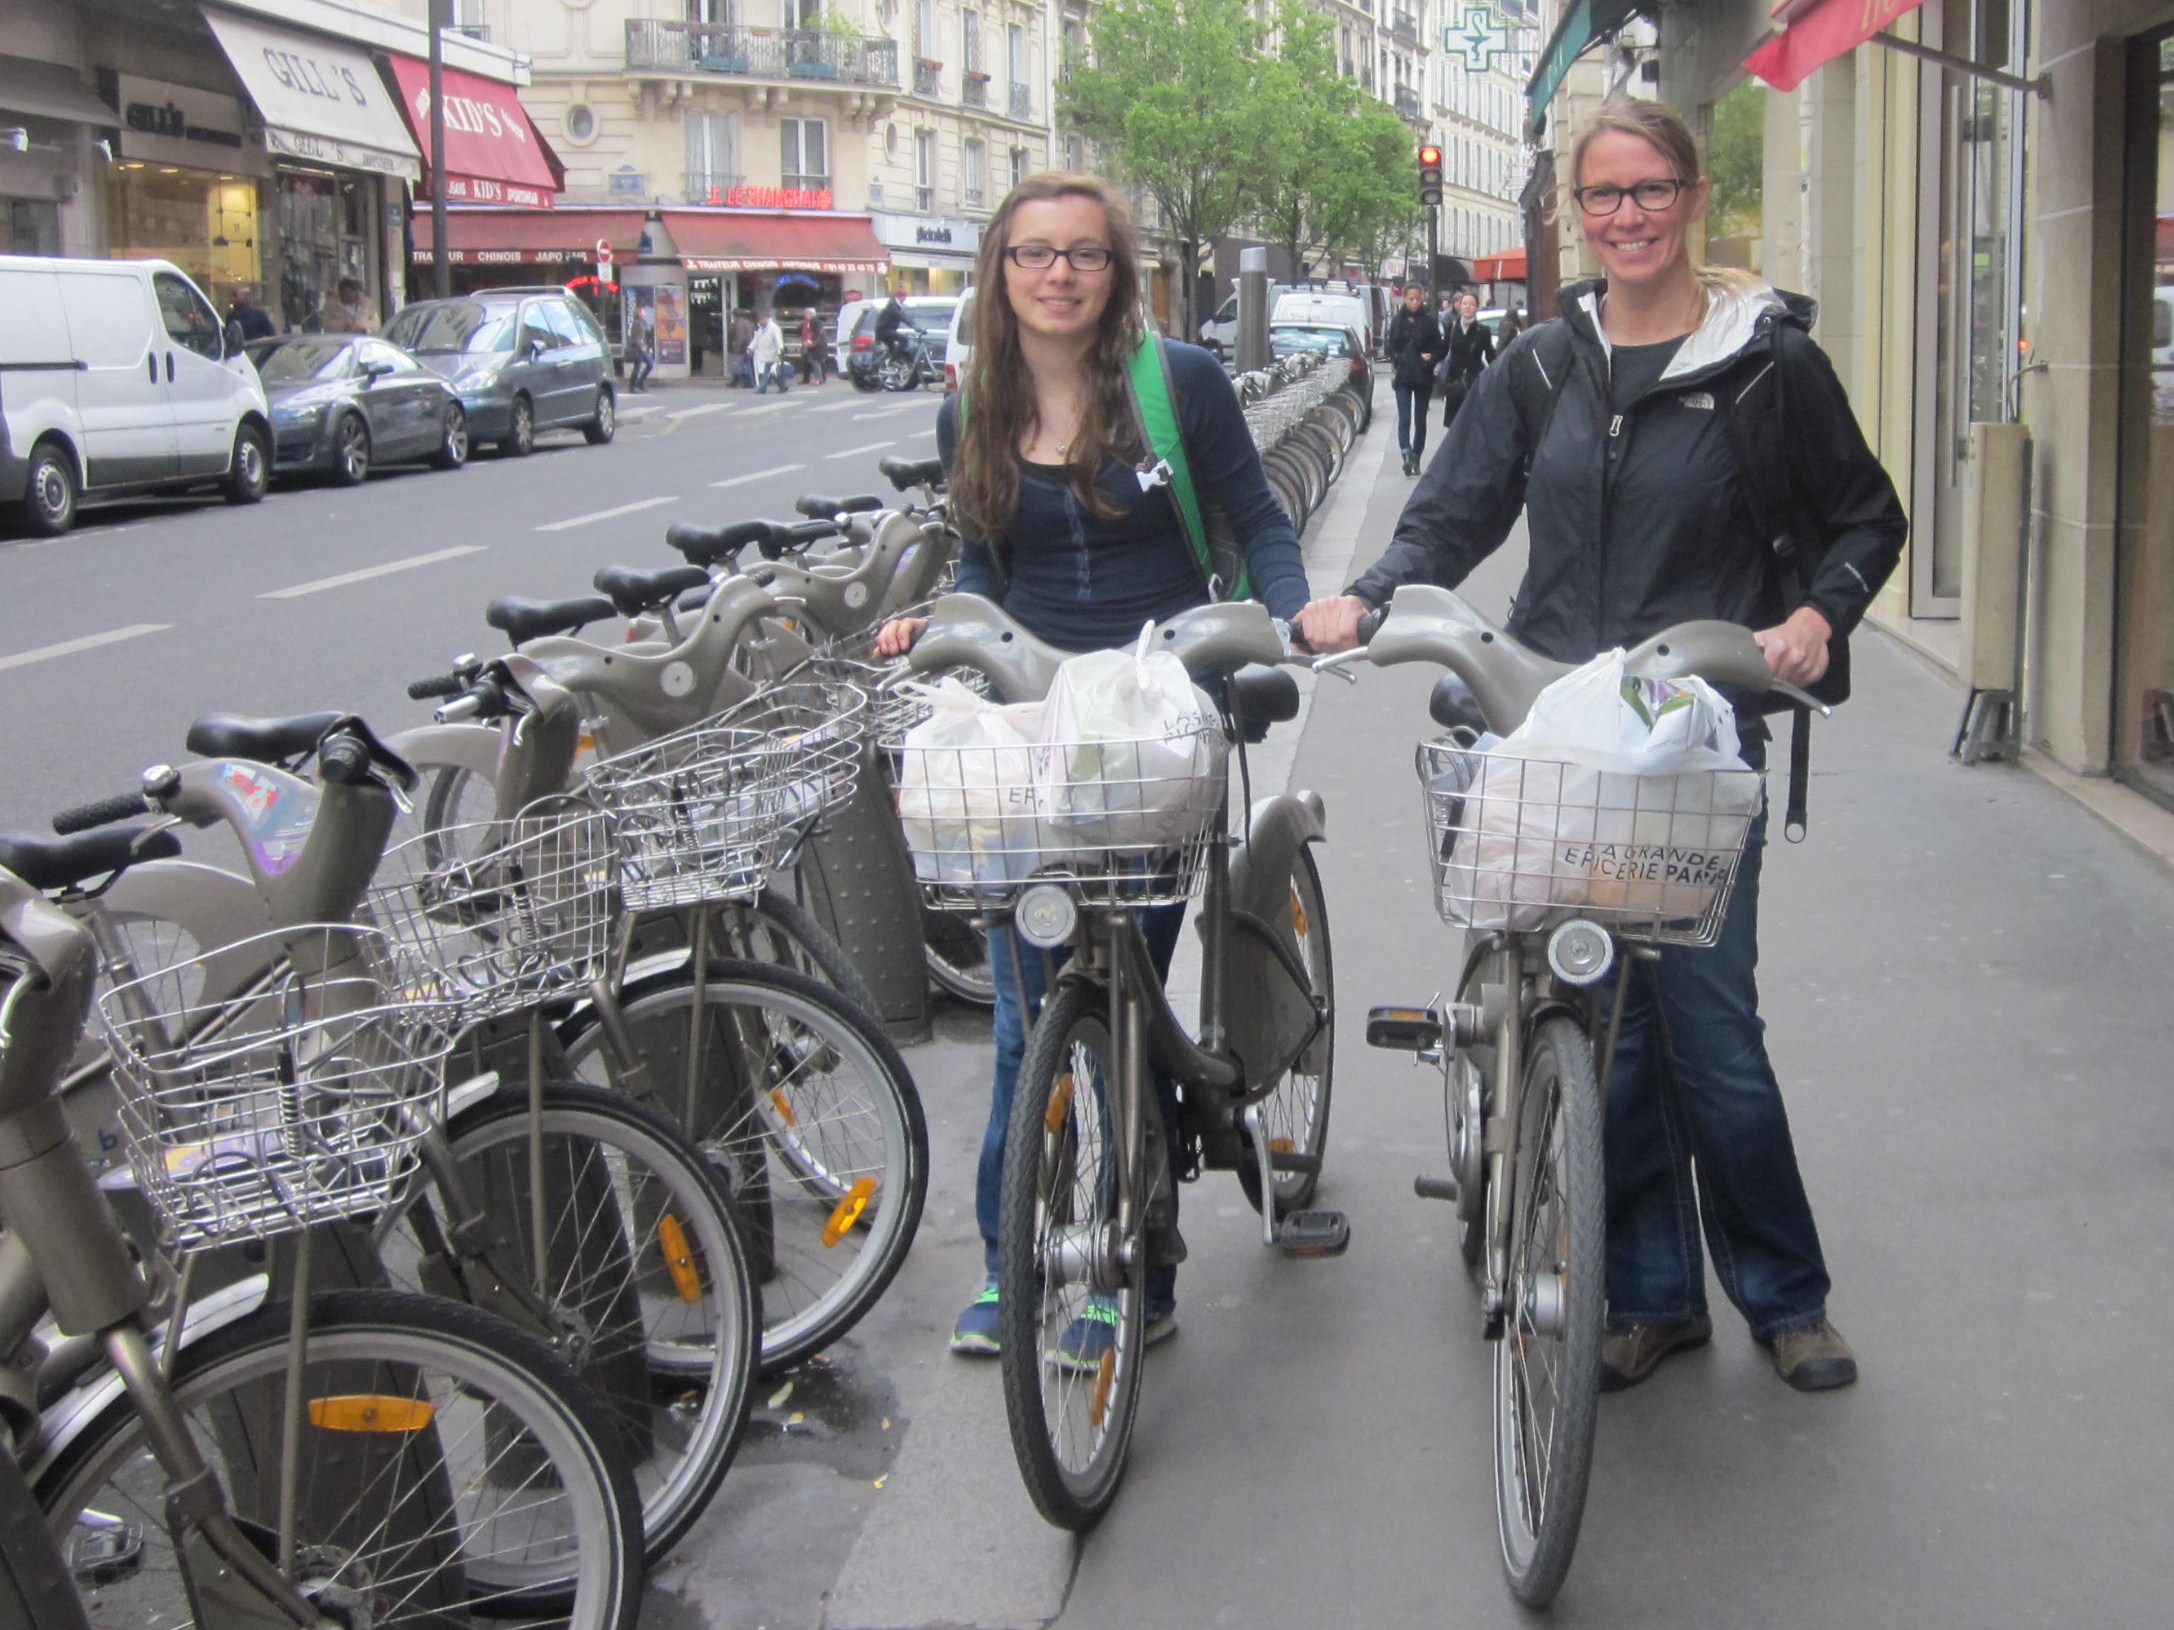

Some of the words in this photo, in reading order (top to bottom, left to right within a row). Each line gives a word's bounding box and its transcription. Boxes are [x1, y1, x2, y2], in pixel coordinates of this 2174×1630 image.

[262, 47, 367, 107] GILL'S
[442, 95, 503, 137] KID'S
[472, 179, 502, 200] KID'S
[413, 250, 464, 262] TRAUR
[478, 251, 521, 262] CHINOIS
[697, 259, 741, 270] TRAITEUR
[1565, 847, 1659, 881] EPICERIE
[1624, 845, 1720, 870] GRANDE
